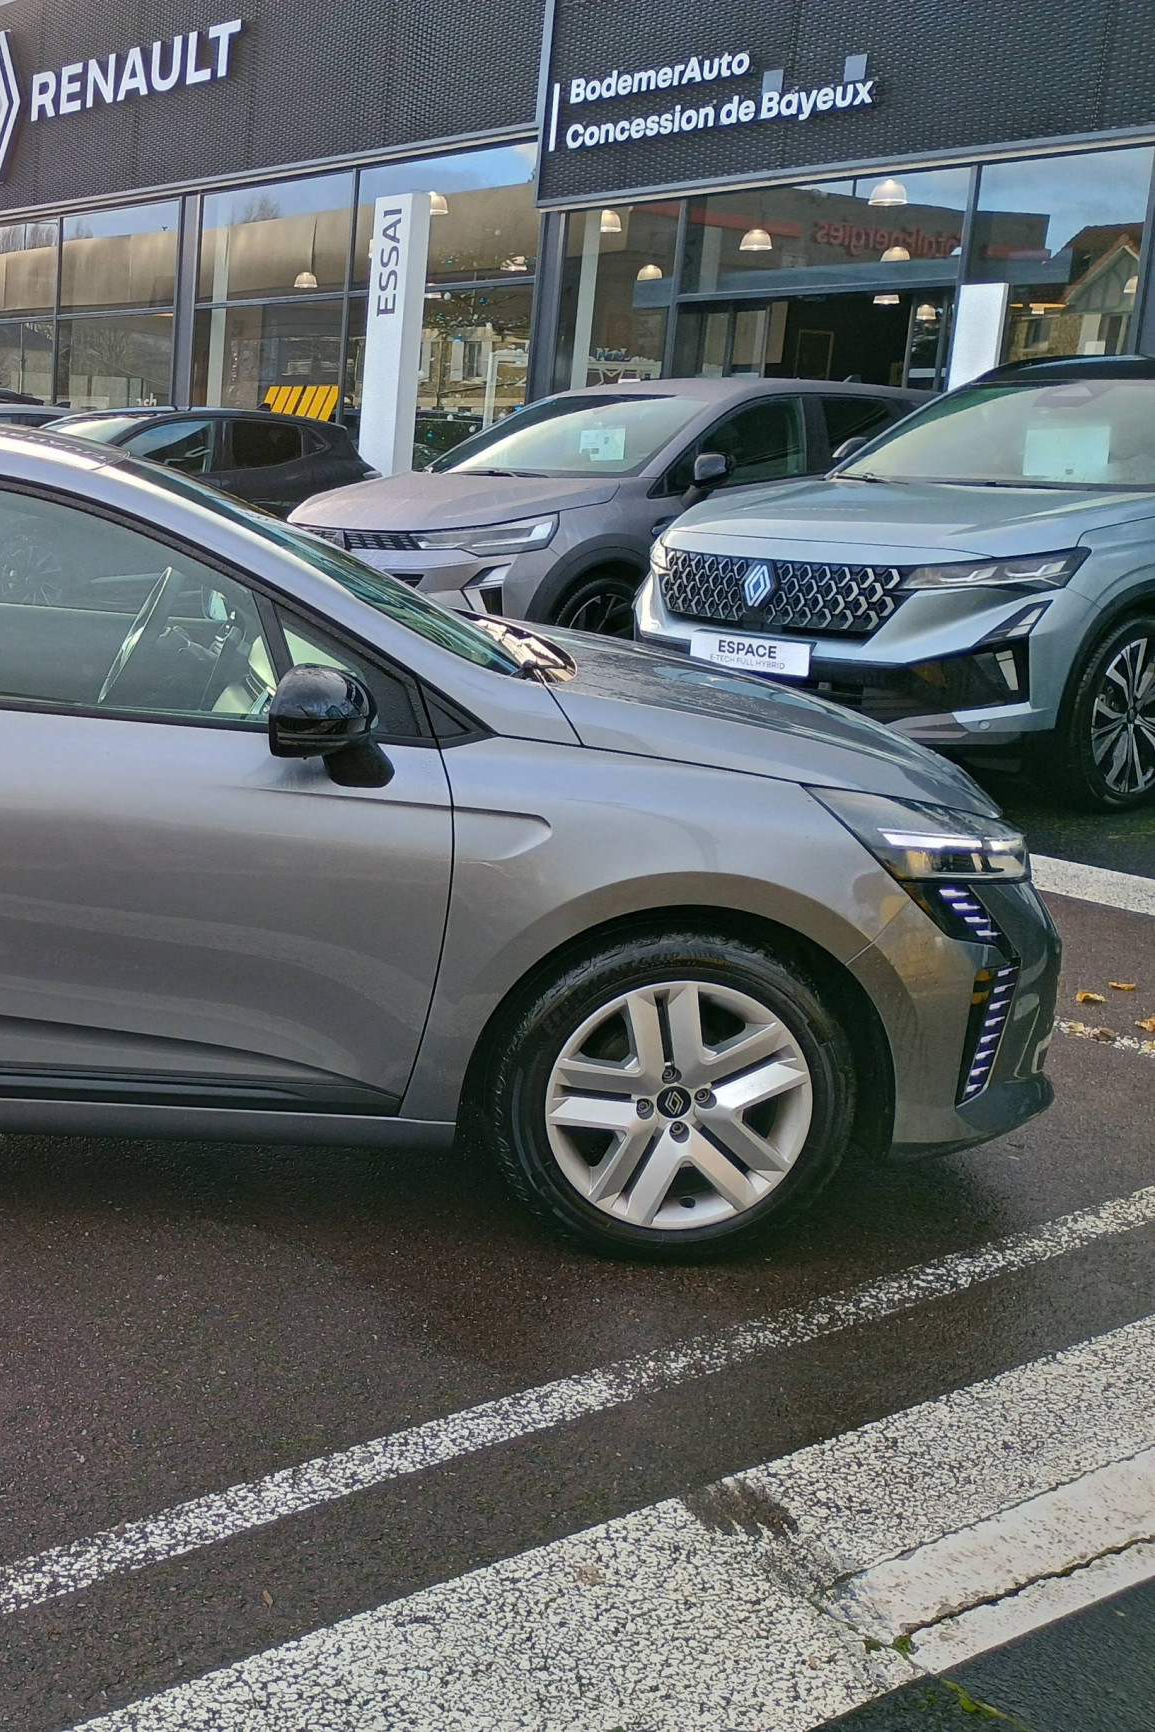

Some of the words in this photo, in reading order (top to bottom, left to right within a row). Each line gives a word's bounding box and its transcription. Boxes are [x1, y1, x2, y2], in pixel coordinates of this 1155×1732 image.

[30, 18, 242, 122] RENAULT
[569, 51, 751, 104] BodemerAuto
[566, 105, 715, 149] Concession
[719, 95, 756, 126] de
[759, 80, 875, 121] Bayeux
[376, 208, 402, 317] ESSAI
[718, 639, 777, 659] ESPACE
[736, 657, 755, 666] FULL
[755, 660, 786, 670] HYBRID
